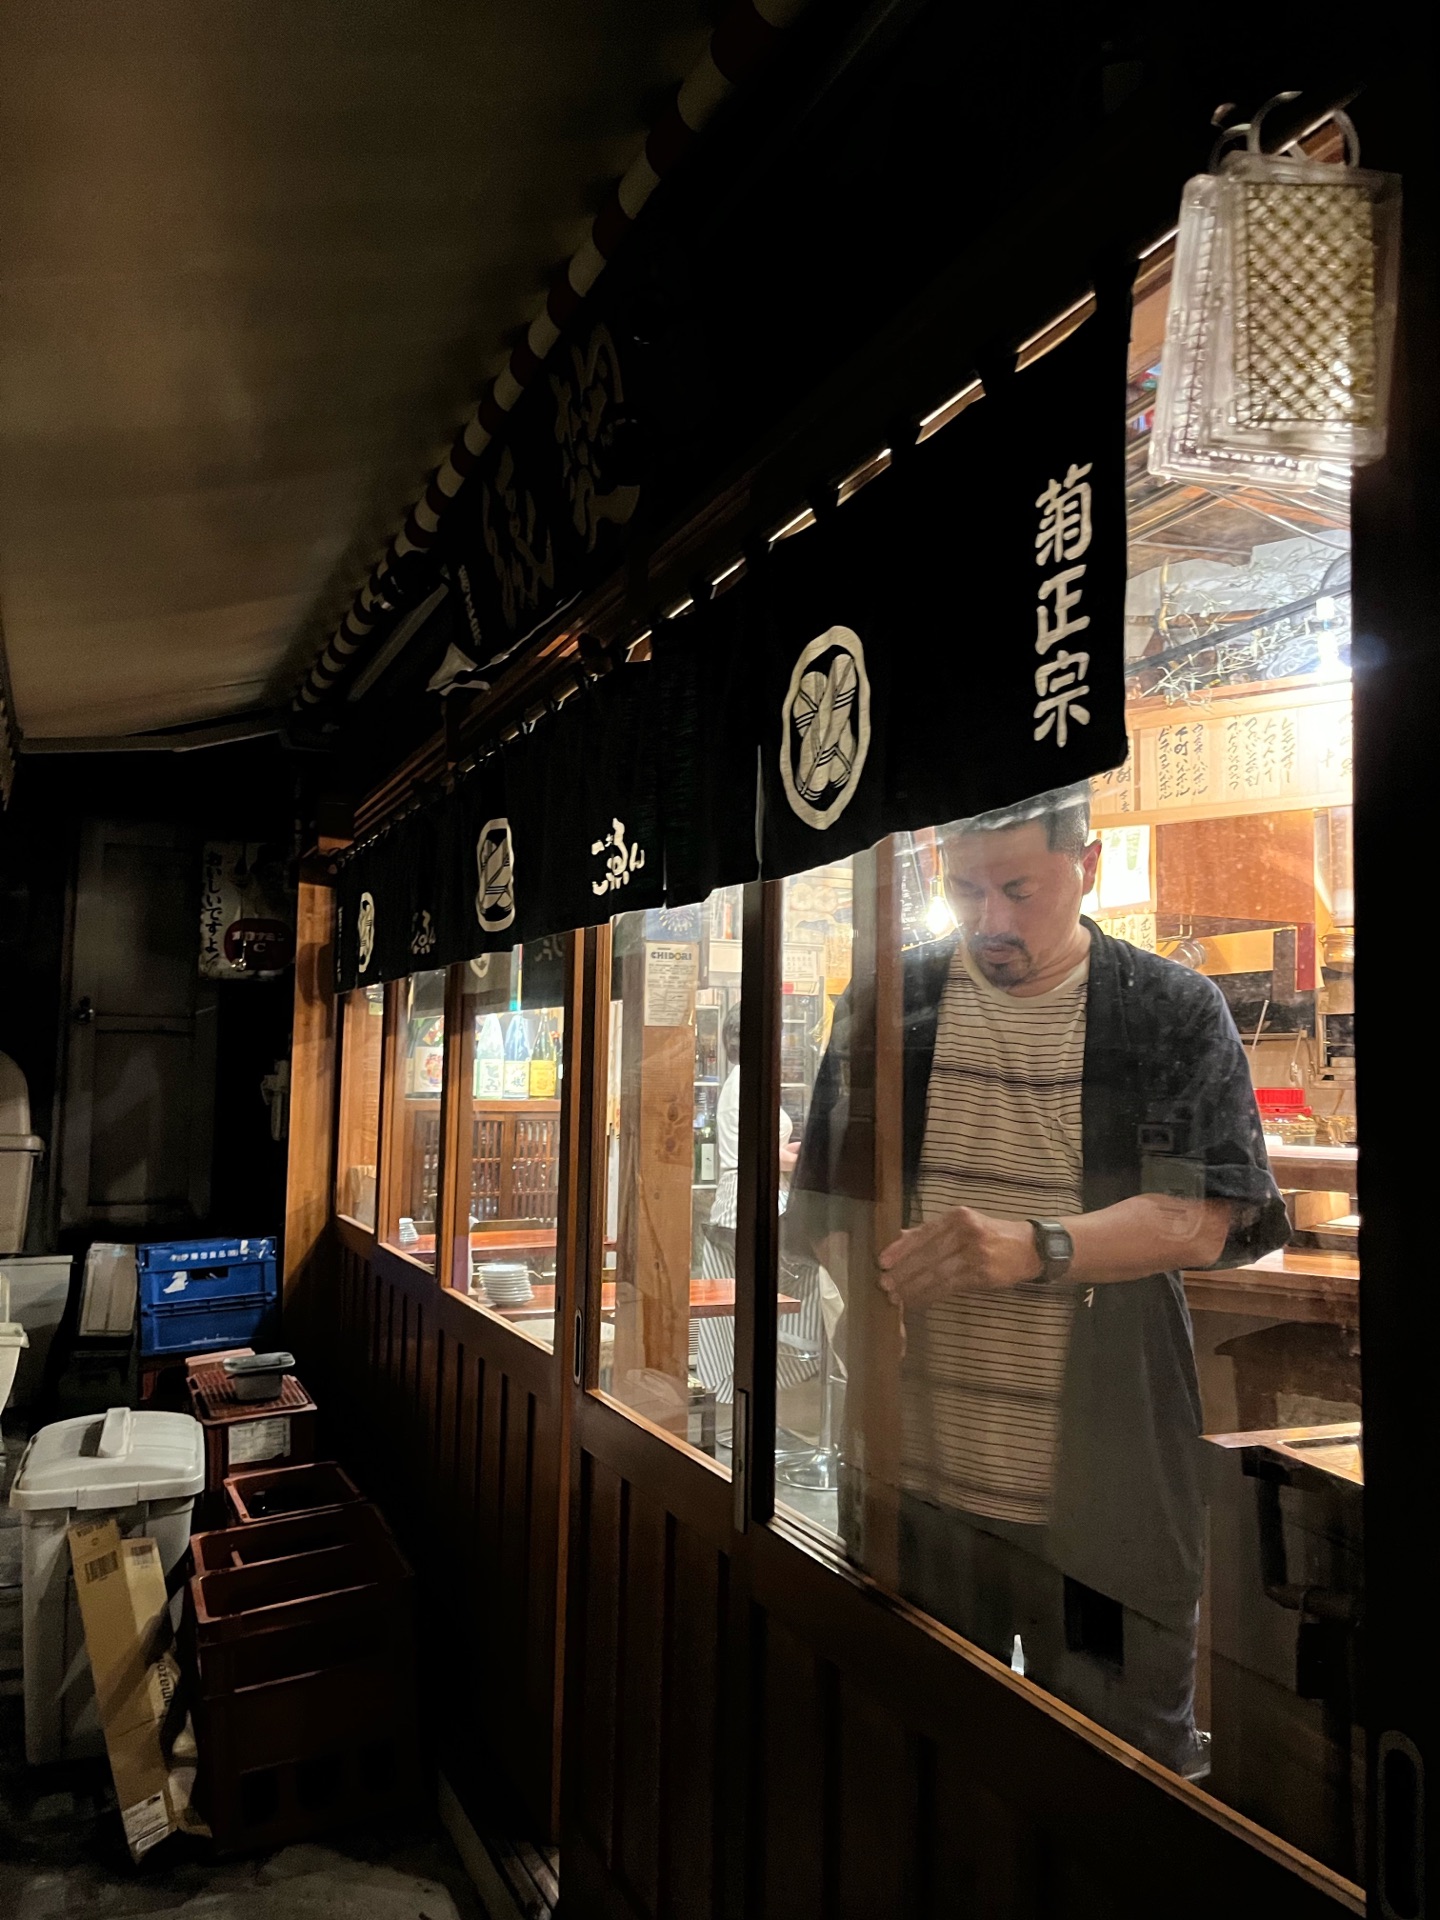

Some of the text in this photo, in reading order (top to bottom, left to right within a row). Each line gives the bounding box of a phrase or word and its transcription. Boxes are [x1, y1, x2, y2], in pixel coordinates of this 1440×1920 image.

[1033, 462, 1093, 748] 菊正宗
[650, 951, 692, 961] CHIDORI
